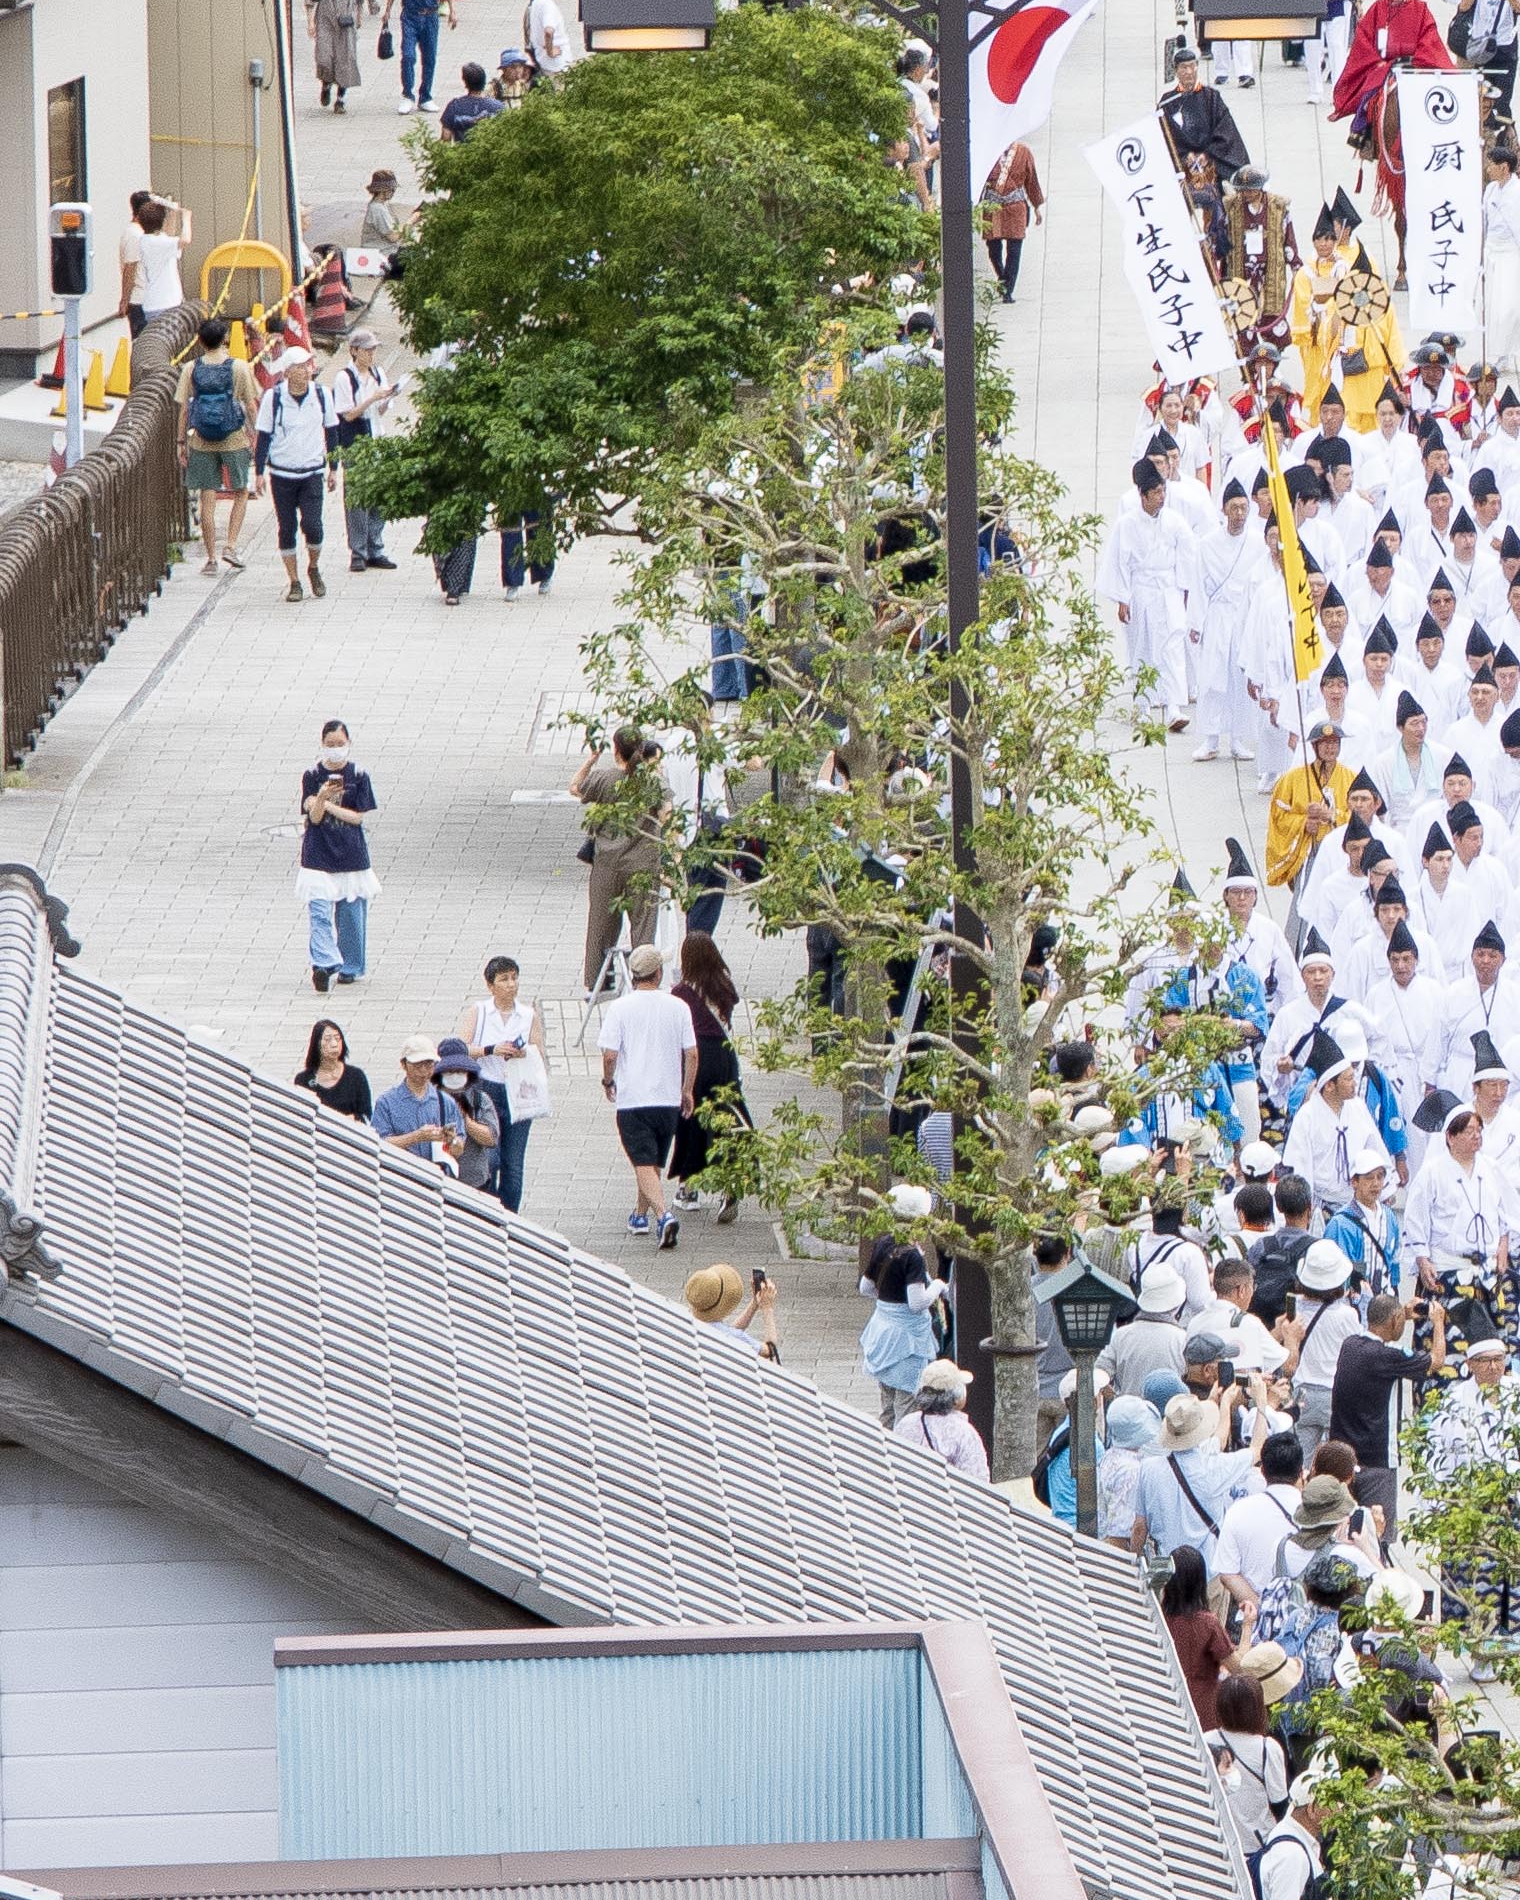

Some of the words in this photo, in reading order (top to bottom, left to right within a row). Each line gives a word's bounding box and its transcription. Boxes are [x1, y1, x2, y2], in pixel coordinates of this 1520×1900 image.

[1127, 184, 1203, 363] 下生氏子中
